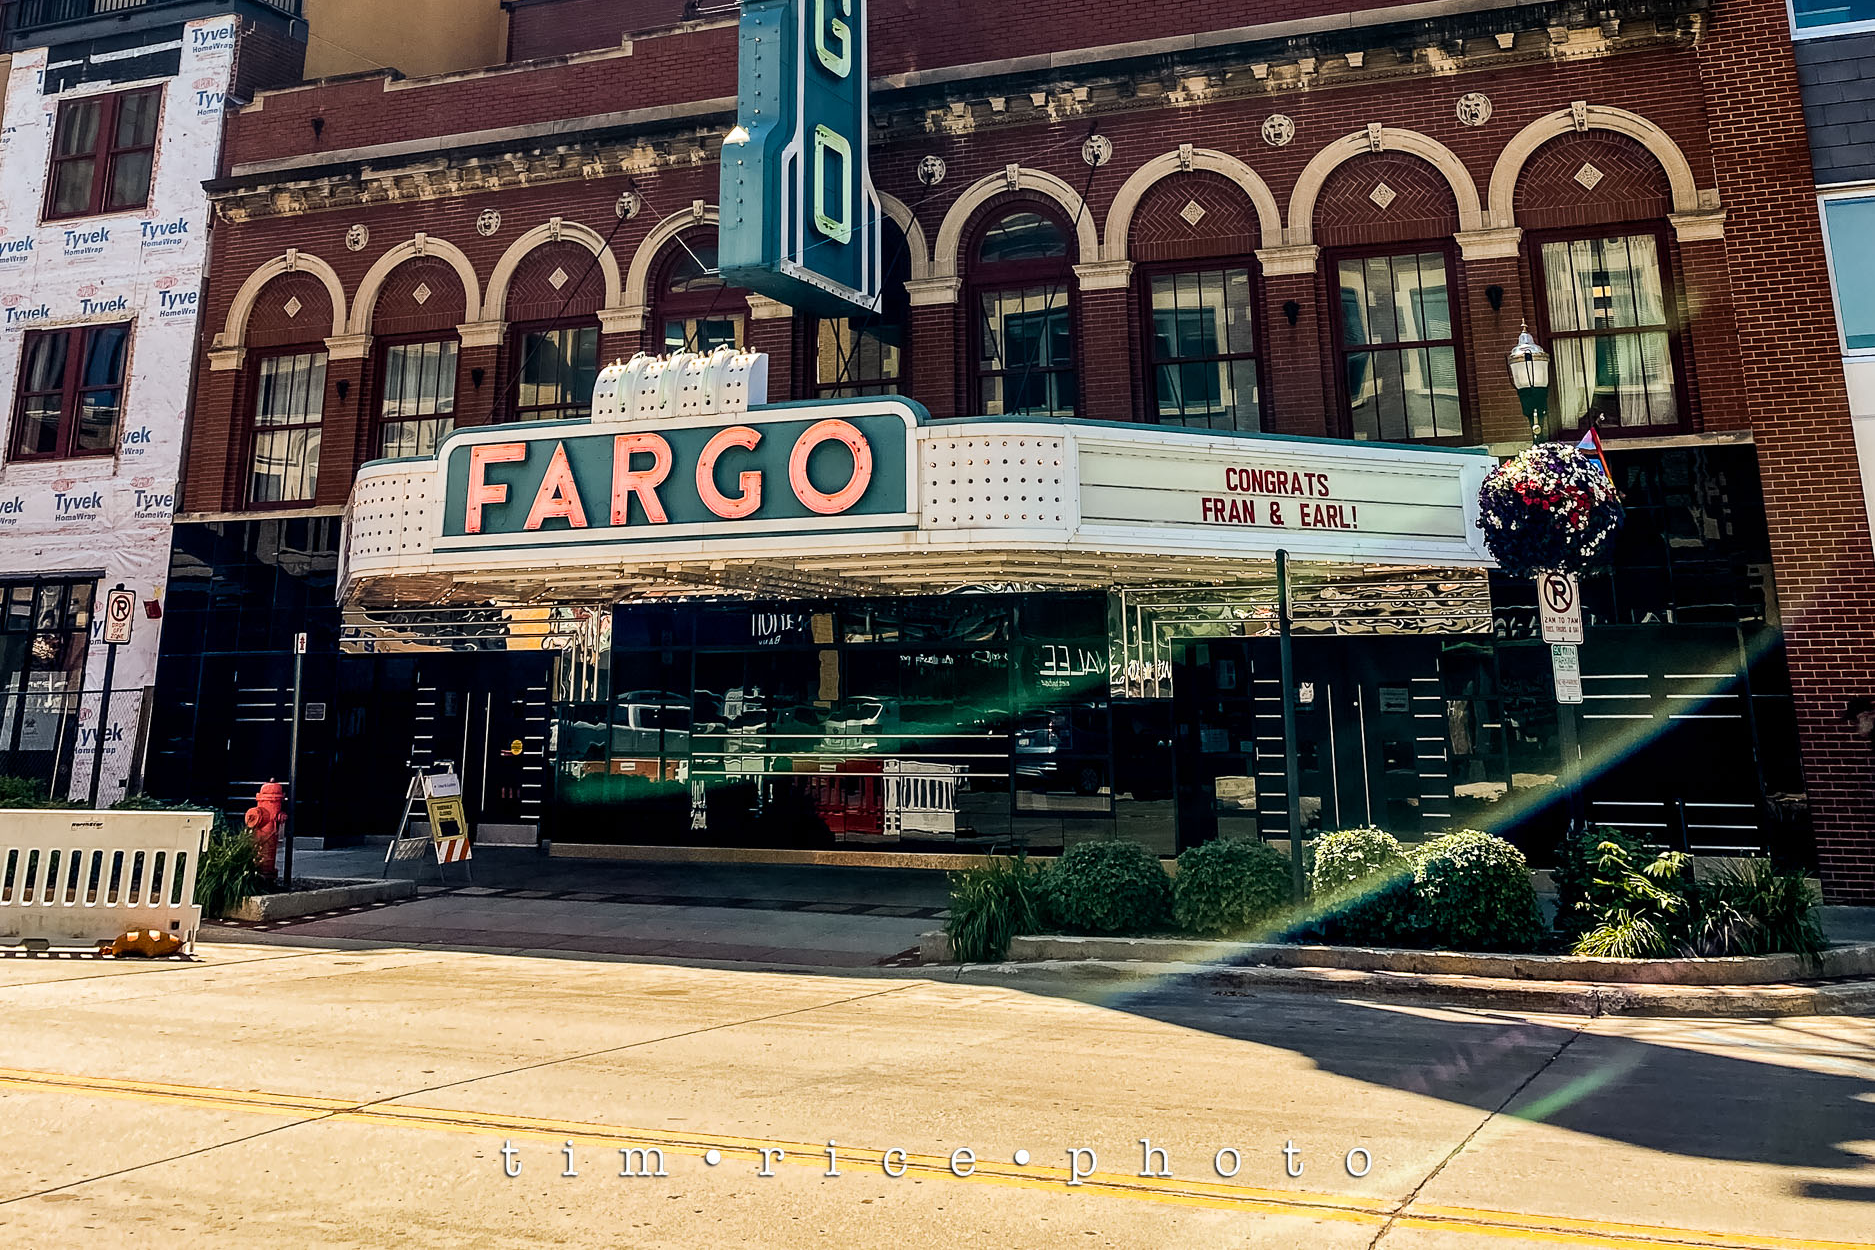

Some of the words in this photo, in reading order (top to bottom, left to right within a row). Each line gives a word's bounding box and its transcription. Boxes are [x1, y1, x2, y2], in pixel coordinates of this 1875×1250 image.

[197, 91, 224, 108] Tyv
[64, 227, 111, 249] Tyvek
[141, 218, 188, 240] Tyvek
[0, 236, 34, 257] yvek
[64, 247, 103, 256] HomeWrap
[141, 238, 182, 248] HomeWrap
[0, 255, 28, 264] meWrap
[80, 295, 128, 315] Tyvek
[159, 290, 197, 309] Tyve
[159, 308, 196, 317] HomeWra
[123, 426, 152, 444] vek
[464, 418, 873, 534] FARGO
[1225, 467, 1329, 497] CONGRATS
[0, 496, 25, 513] vek
[54, 491, 103, 514] Tyvek
[134, 490, 173, 511] Tyve
[55, 513, 97, 522] HomeWrap
[134, 511, 172, 519] HomeWra
[1201, 497, 1256, 524] FRAN
[1269, 501, 1285, 526] &
[1300, 503, 1358, 530] EARL!
[1544, 616, 1556, 624] 2AM
[1558, 616, 1566, 624] TO
[78, 723, 124, 746] yek
